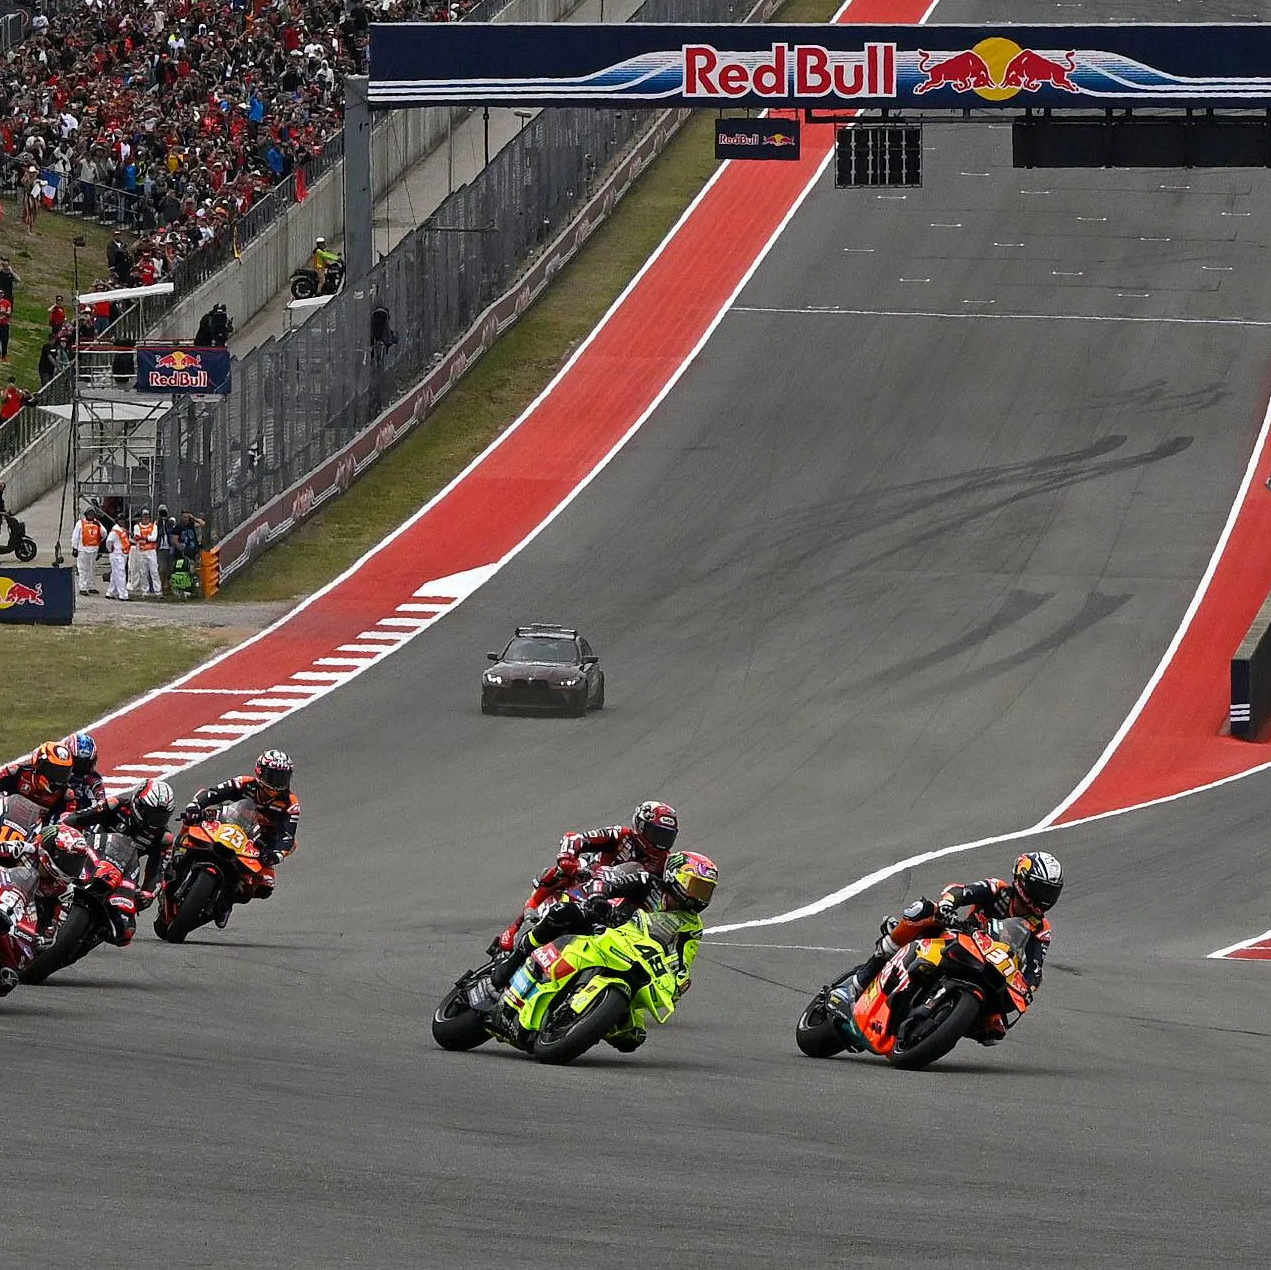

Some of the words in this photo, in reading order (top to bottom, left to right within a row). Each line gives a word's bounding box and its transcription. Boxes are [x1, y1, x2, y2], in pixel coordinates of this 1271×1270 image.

[682, 42, 789, 97] Red
[794, 42, 897, 97] Bull
[718, 133, 739, 145] Red
[739, 133, 760, 145] Bull
[149, 371, 178, 387] Red
[178, 371, 208, 387] Bull
[218, 826, 245, 849] 23
[985, 947, 1016, 977] 37
